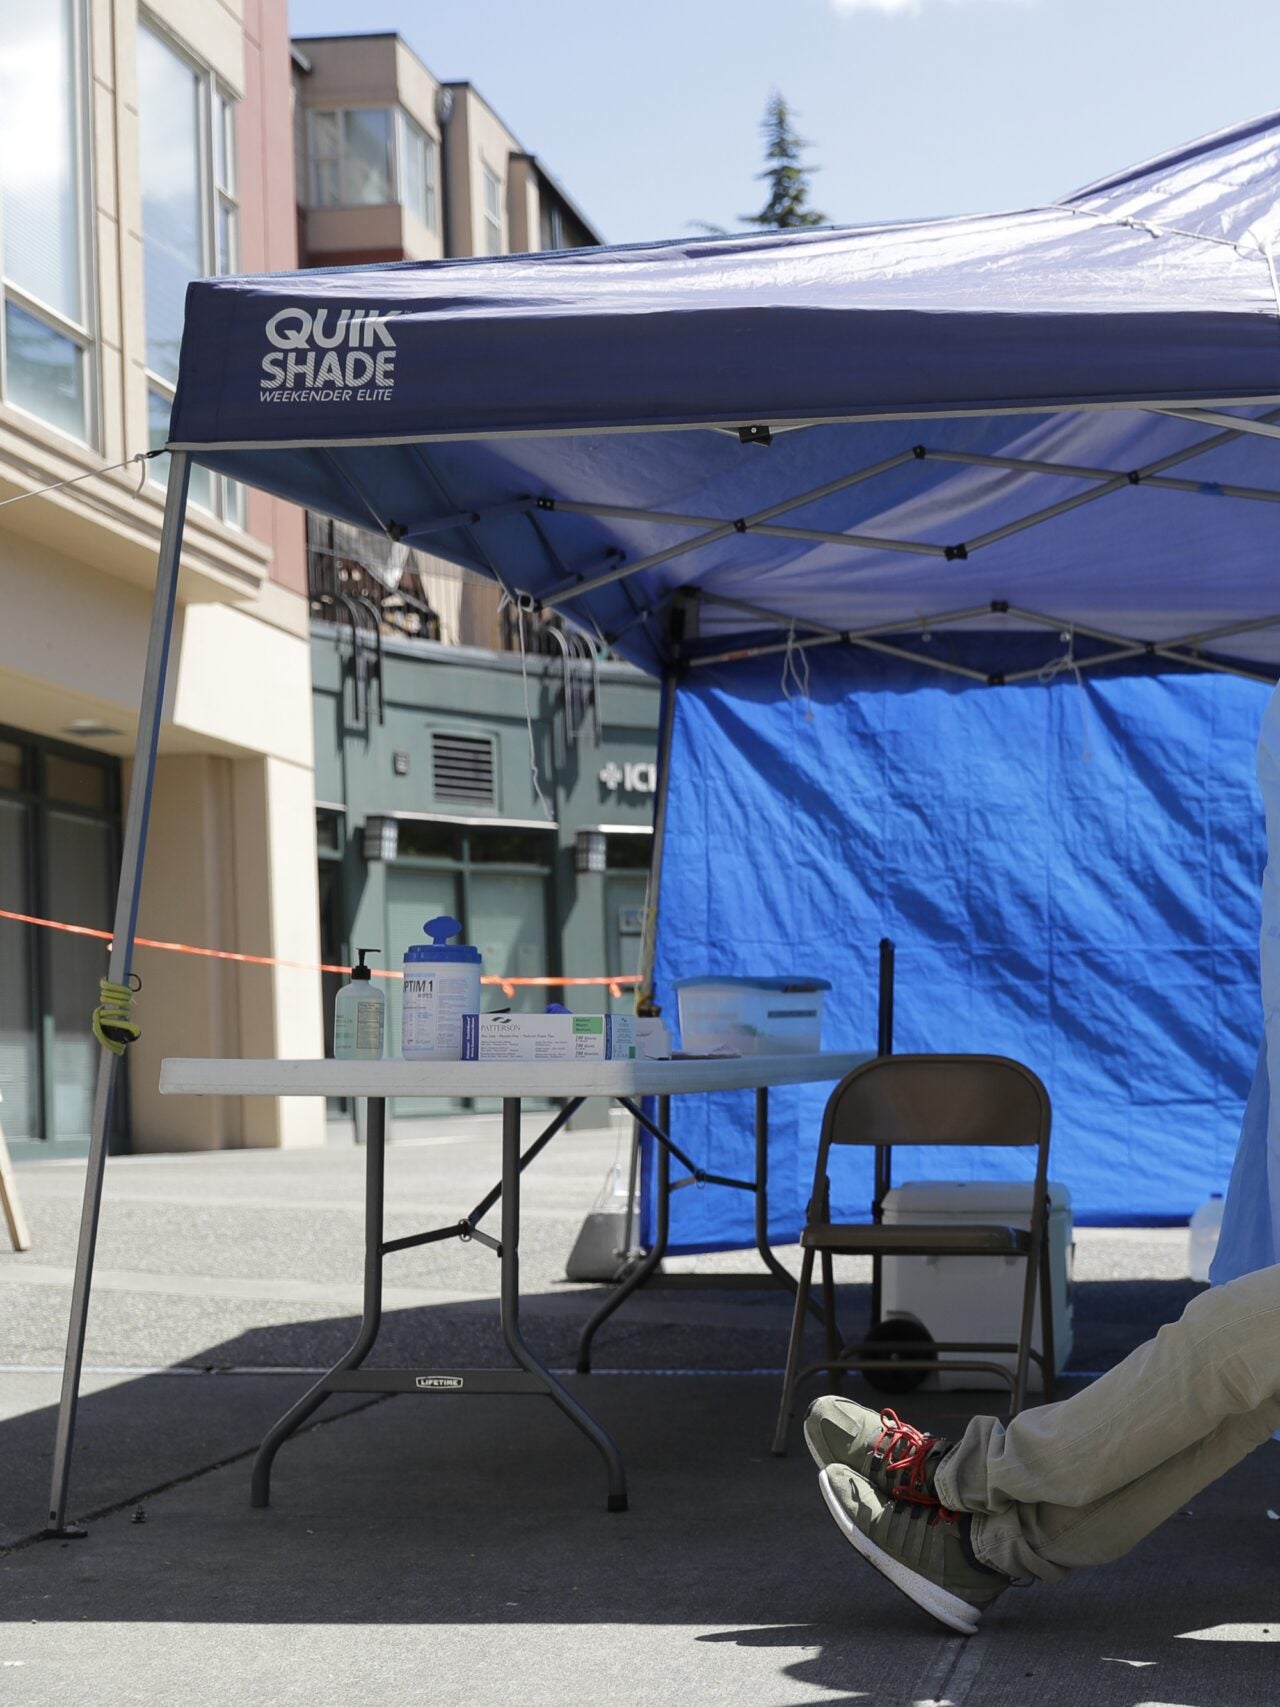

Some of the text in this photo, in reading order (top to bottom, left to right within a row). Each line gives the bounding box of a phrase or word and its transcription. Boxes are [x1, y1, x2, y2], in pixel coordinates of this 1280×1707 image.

[265, 307, 402, 349] QUIK
[260, 350, 397, 389] SHADE
[260, 389, 393, 402] WEEKENDER ELITE
[428, 980, 433, 992] 1
